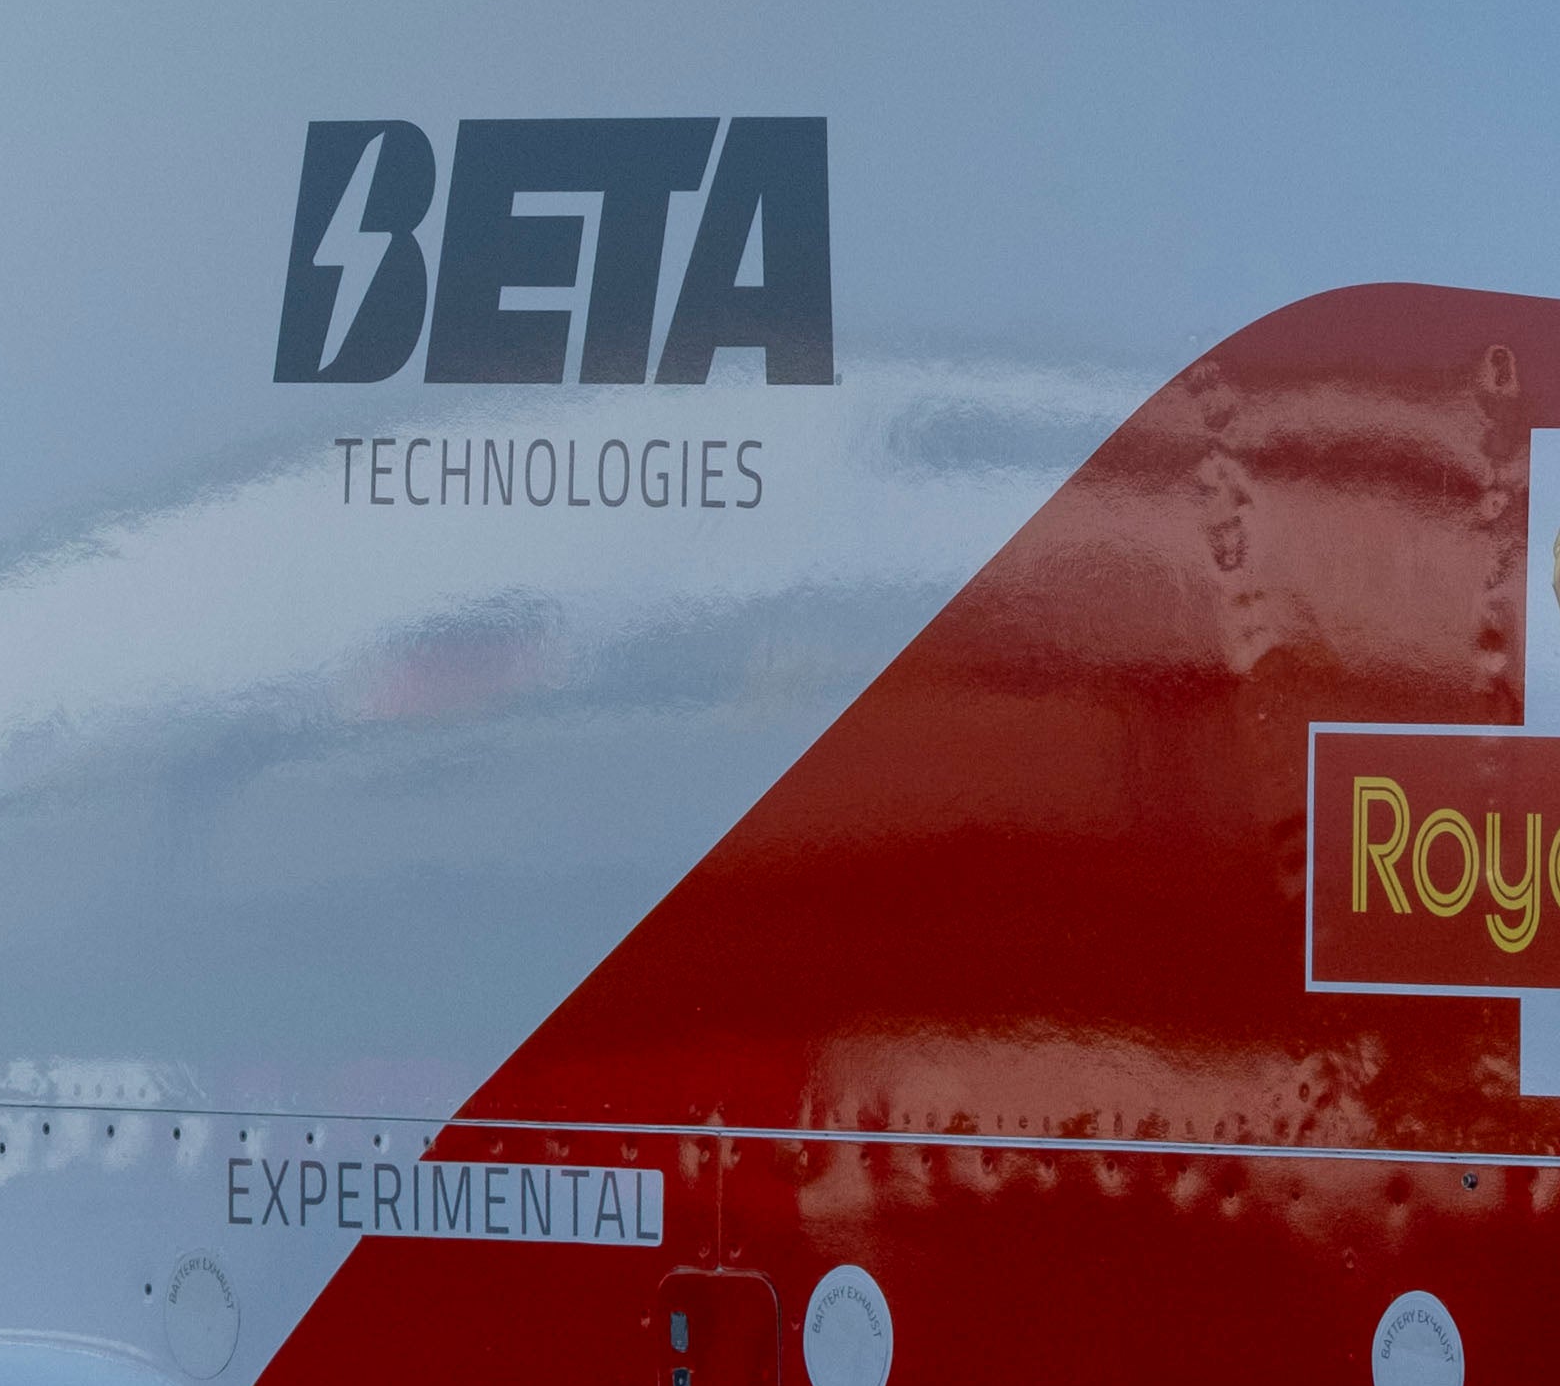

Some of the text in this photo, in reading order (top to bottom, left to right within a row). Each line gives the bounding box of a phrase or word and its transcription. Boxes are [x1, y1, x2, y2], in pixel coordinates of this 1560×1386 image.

[273, 116, 834, 385] BETA
[334, 437, 763, 508] TECHNOLOGIES
[228, 1158, 659, 1241] EXPERIMENTAL
[169, 1257, 234, 1309] BATTERY EXHAUST
[812, 1285, 882, 1337] BATTERY EXHAUST
[1381, 1310, 1454, 1362] BATTERY EXHAUST
